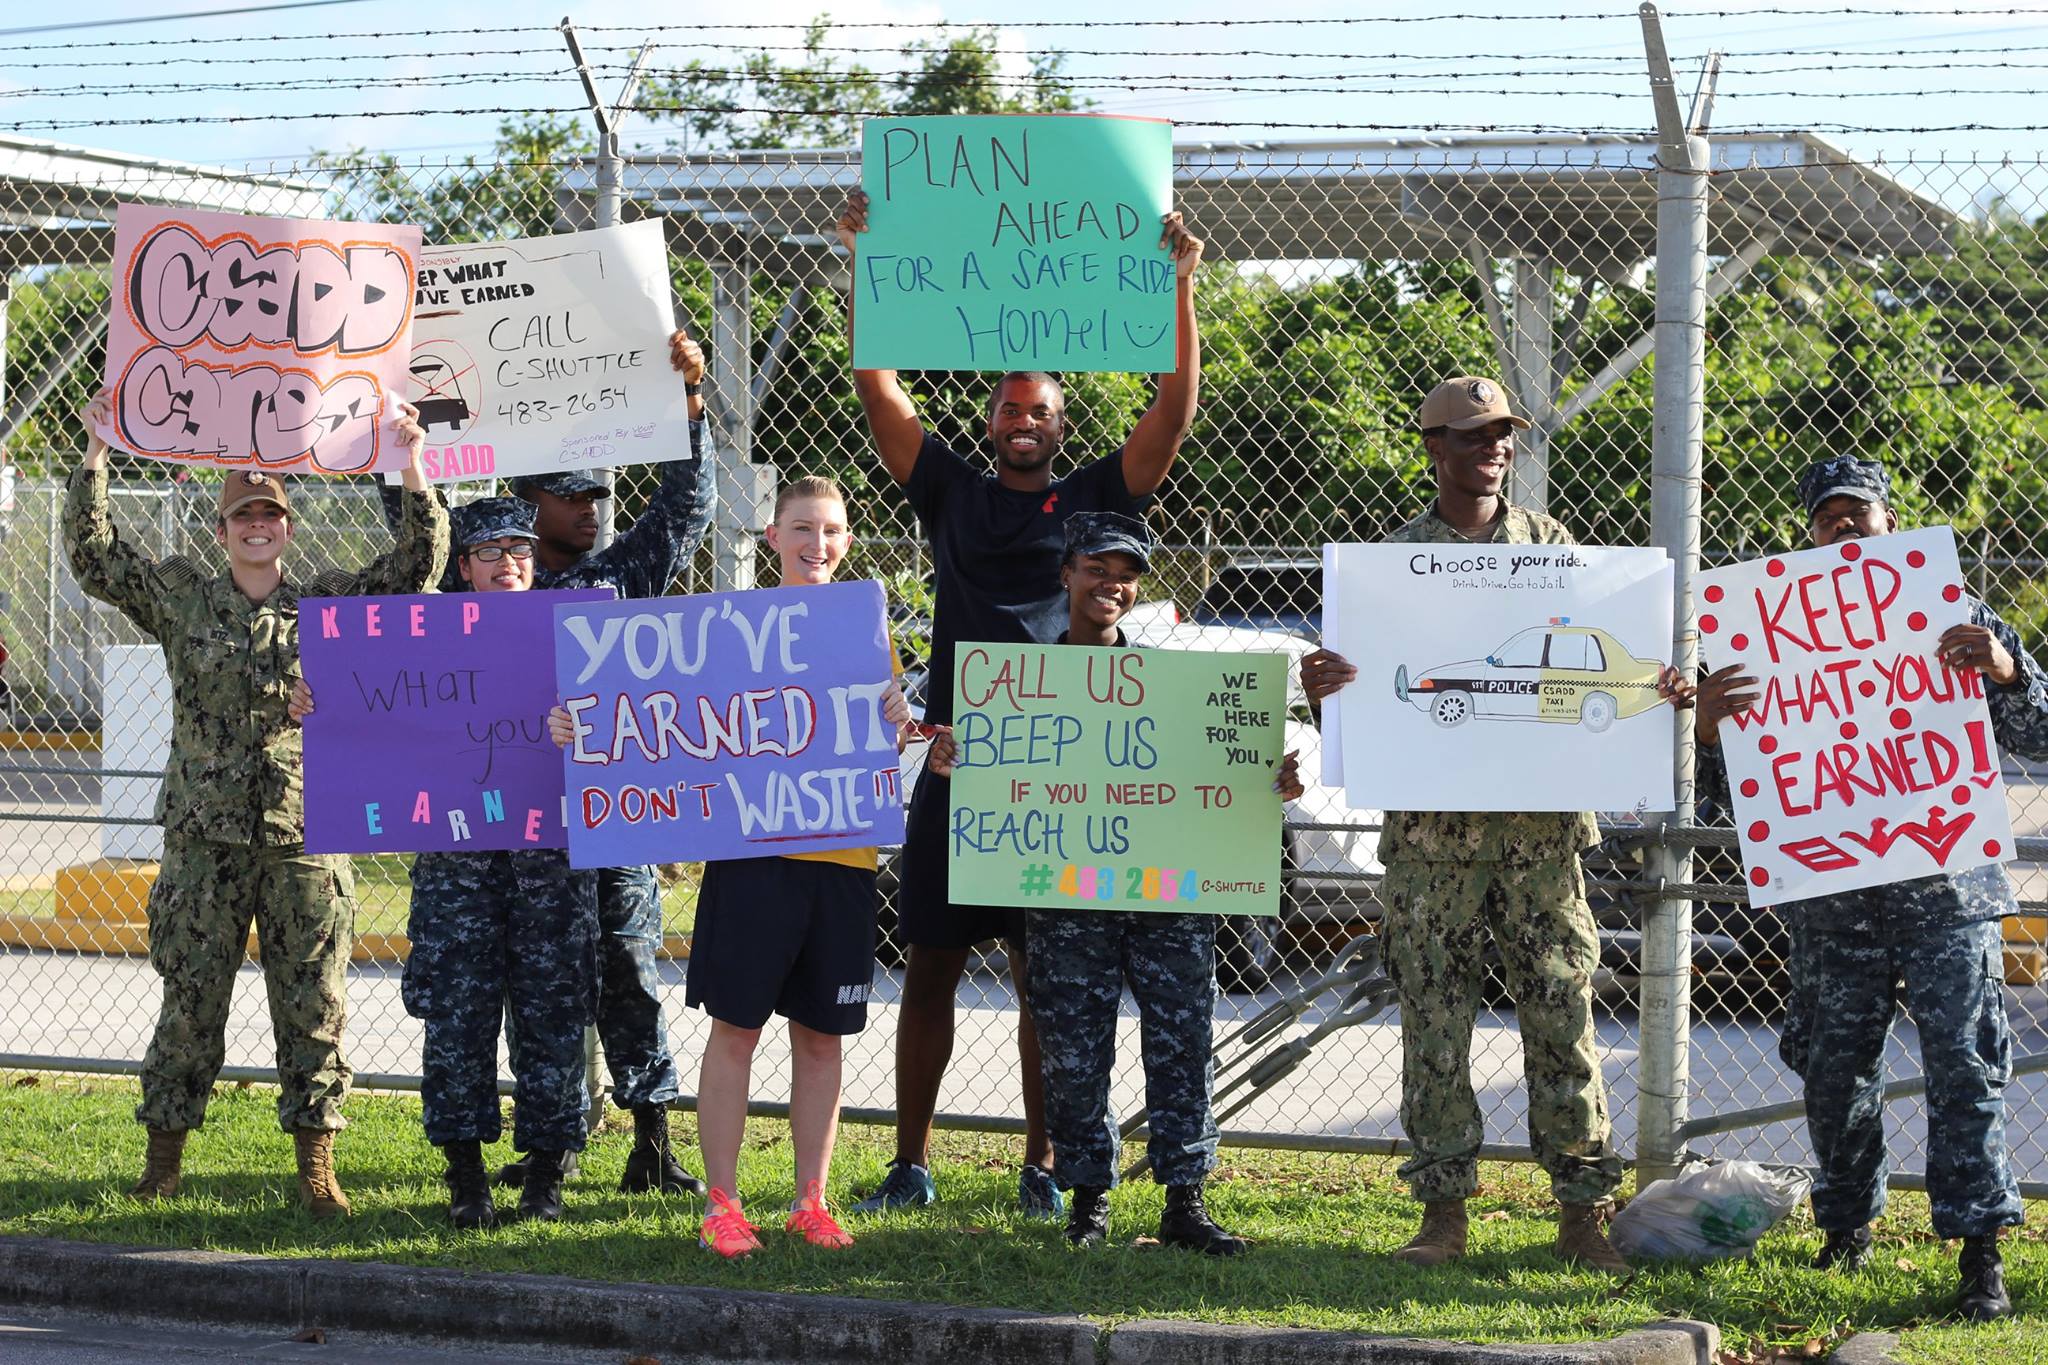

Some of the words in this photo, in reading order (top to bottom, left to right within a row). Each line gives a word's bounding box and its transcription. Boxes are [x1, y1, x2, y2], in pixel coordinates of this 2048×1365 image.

[883, 127, 1029, 201] PLAN
[992, 201, 1140, 247] AHEAD
[417, 269, 438, 287] EP
[443, 260, 508, 285] WHAT
[867, 254, 944, 303] FOR
[962, 251, 991, 290] A
[1012, 249, 1100, 290] SAFE
[1118, 254, 1176, 294] RIDE
[461, 283, 535, 305] EARNED
[489, 311, 587, 351] CALL
[497, 350, 648, 387] C-SHUTTLE
[498, 385, 629, 426] 483-2654
[559, 444, 616, 464] CSADD
[1409, 553, 1498, 575] Choose
[1511, 556, 1551, 575] your
[1554, 552, 1588, 568] ride.
[1452, 578, 1478, 589] Drink.
[1481, 577, 1507, 589] Drive.
[1508, 577, 1524, 589] Go
[1527, 577, 1539, 589] to
[1539, 576, 1565, 589] Jail.
[321, 602, 480, 638] KEEP
[1754, 558, 1902, 663] KEEP
[563, 599, 810, 685] YOU'VE
[960, 648, 1058, 712] CALL
[1087, 653, 1145, 707] US
[1222, 672, 1258, 691] WE
[1488, 681, 1534, 694] POLICE
[1543, 686, 1575, 696] CSADD
[1732, 659, 1863, 732] WHAT
[1206, 692, 1242, 709] ARE
[1546, 698, 1564, 706] TAXI
[564, 685, 817, 766] EARNED
[1206, 726, 1240, 745] FOR
[1224, 710, 1270, 728] HERE
[955, 712, 1083, 770] BEEP
[1104, 716, 1158, 770] US
[1225, 747, 1259, 766] YOU
[581, 781, 720, 829] DON'T
[724, 767, 874, 836] WASTE
[1010, 779, 1032, 804] IF
[1045, 783, 1087, 805] YOU
[1106, 783, 1177, 806] NEED
[1194, 785, 1233, 810] TO
[950, 806, 1069, 861] REACH
[1086, 815, 1130, 855] US
[1125, 867, 1200, 902] 2654
[1201, 880, 1266, 894] C-SHUTTLE
